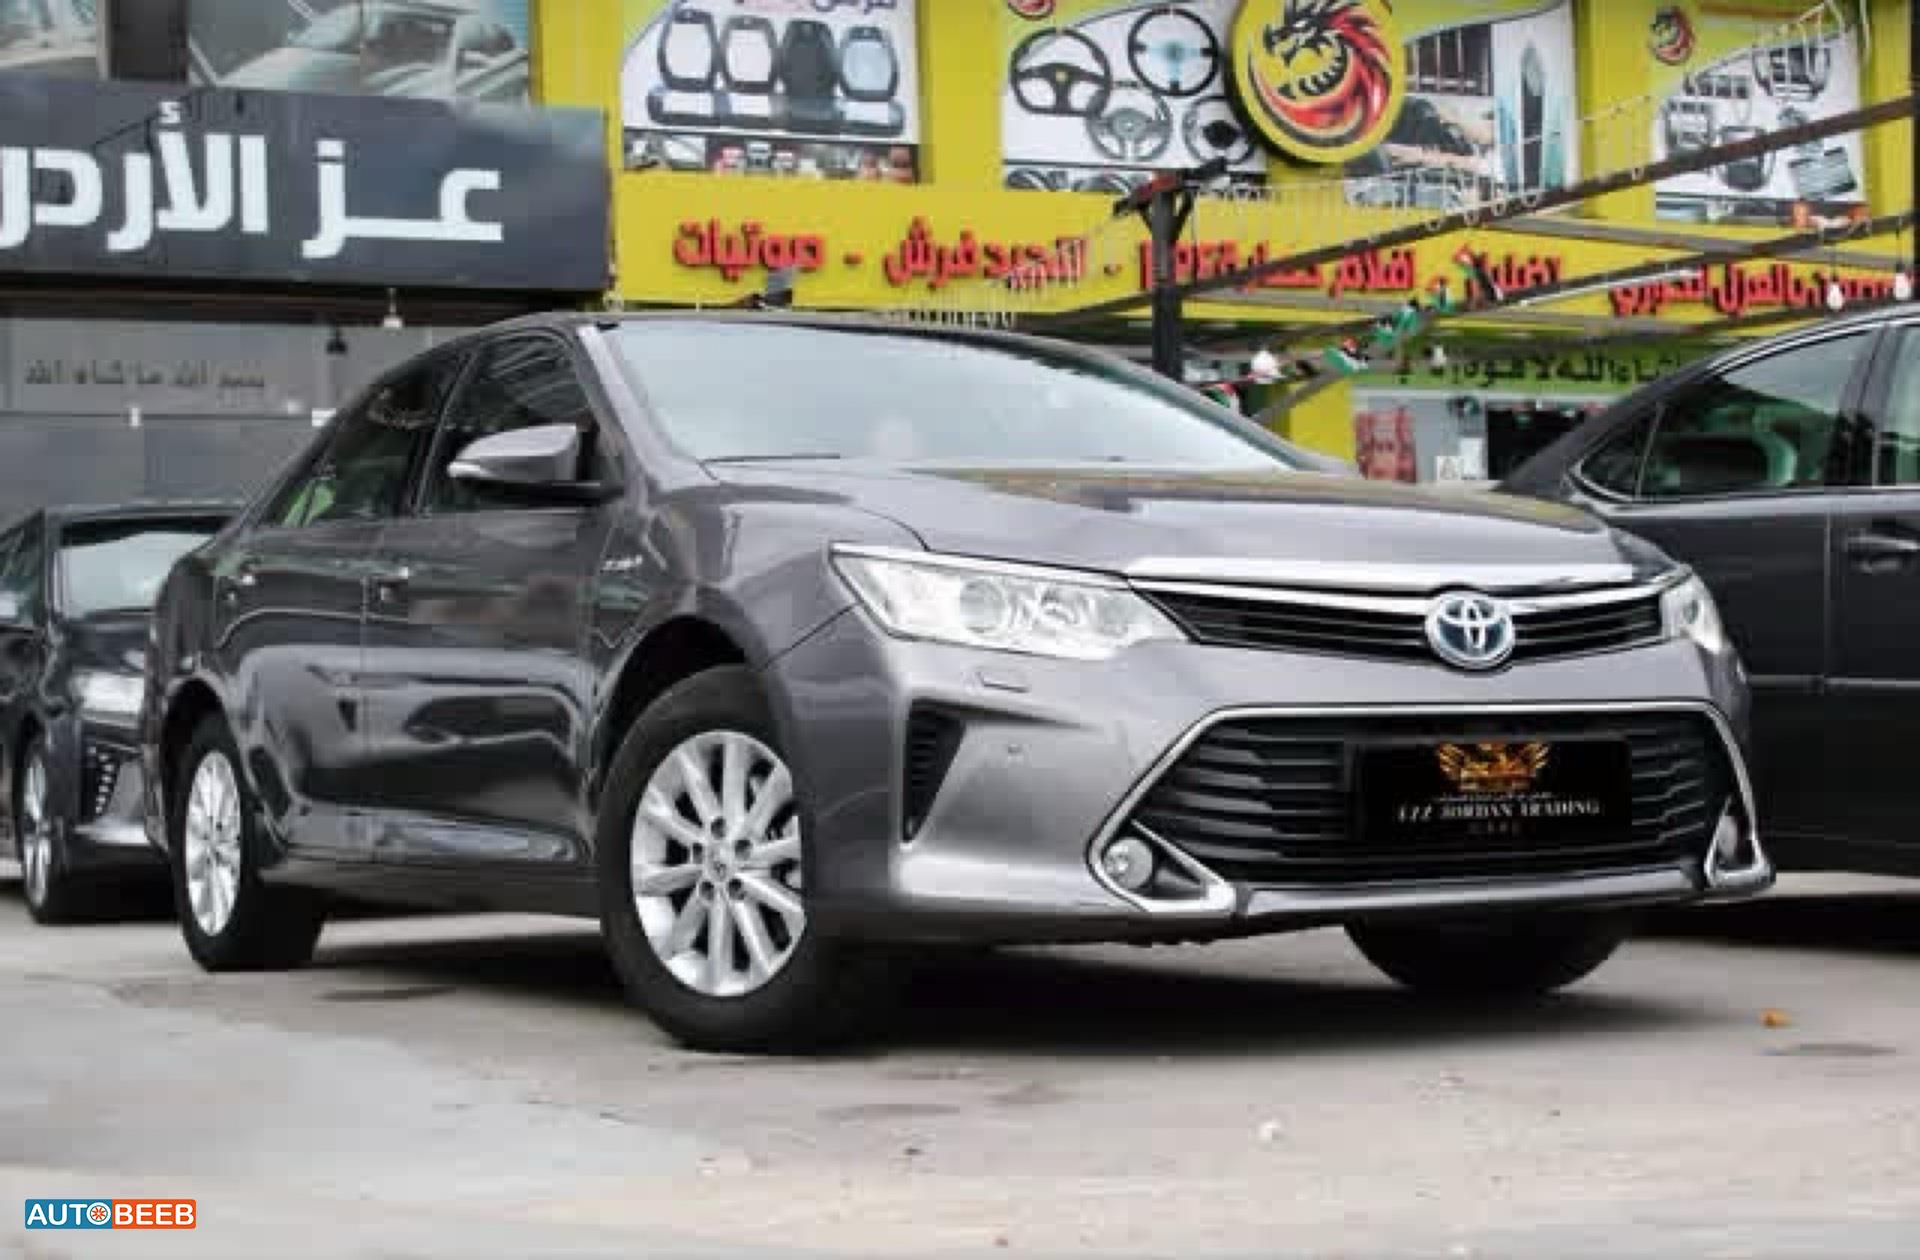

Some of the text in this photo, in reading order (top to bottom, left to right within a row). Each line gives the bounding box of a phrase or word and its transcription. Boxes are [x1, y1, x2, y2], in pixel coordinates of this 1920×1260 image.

[302, 139, 502, 259] عز
[674, 217, 825, 283] صوتيات
[884, 215, 977, 290] فرش
[1440, 802, 1514, 819] JORDAN
[1520, 799, 1601, 817] TRADING
